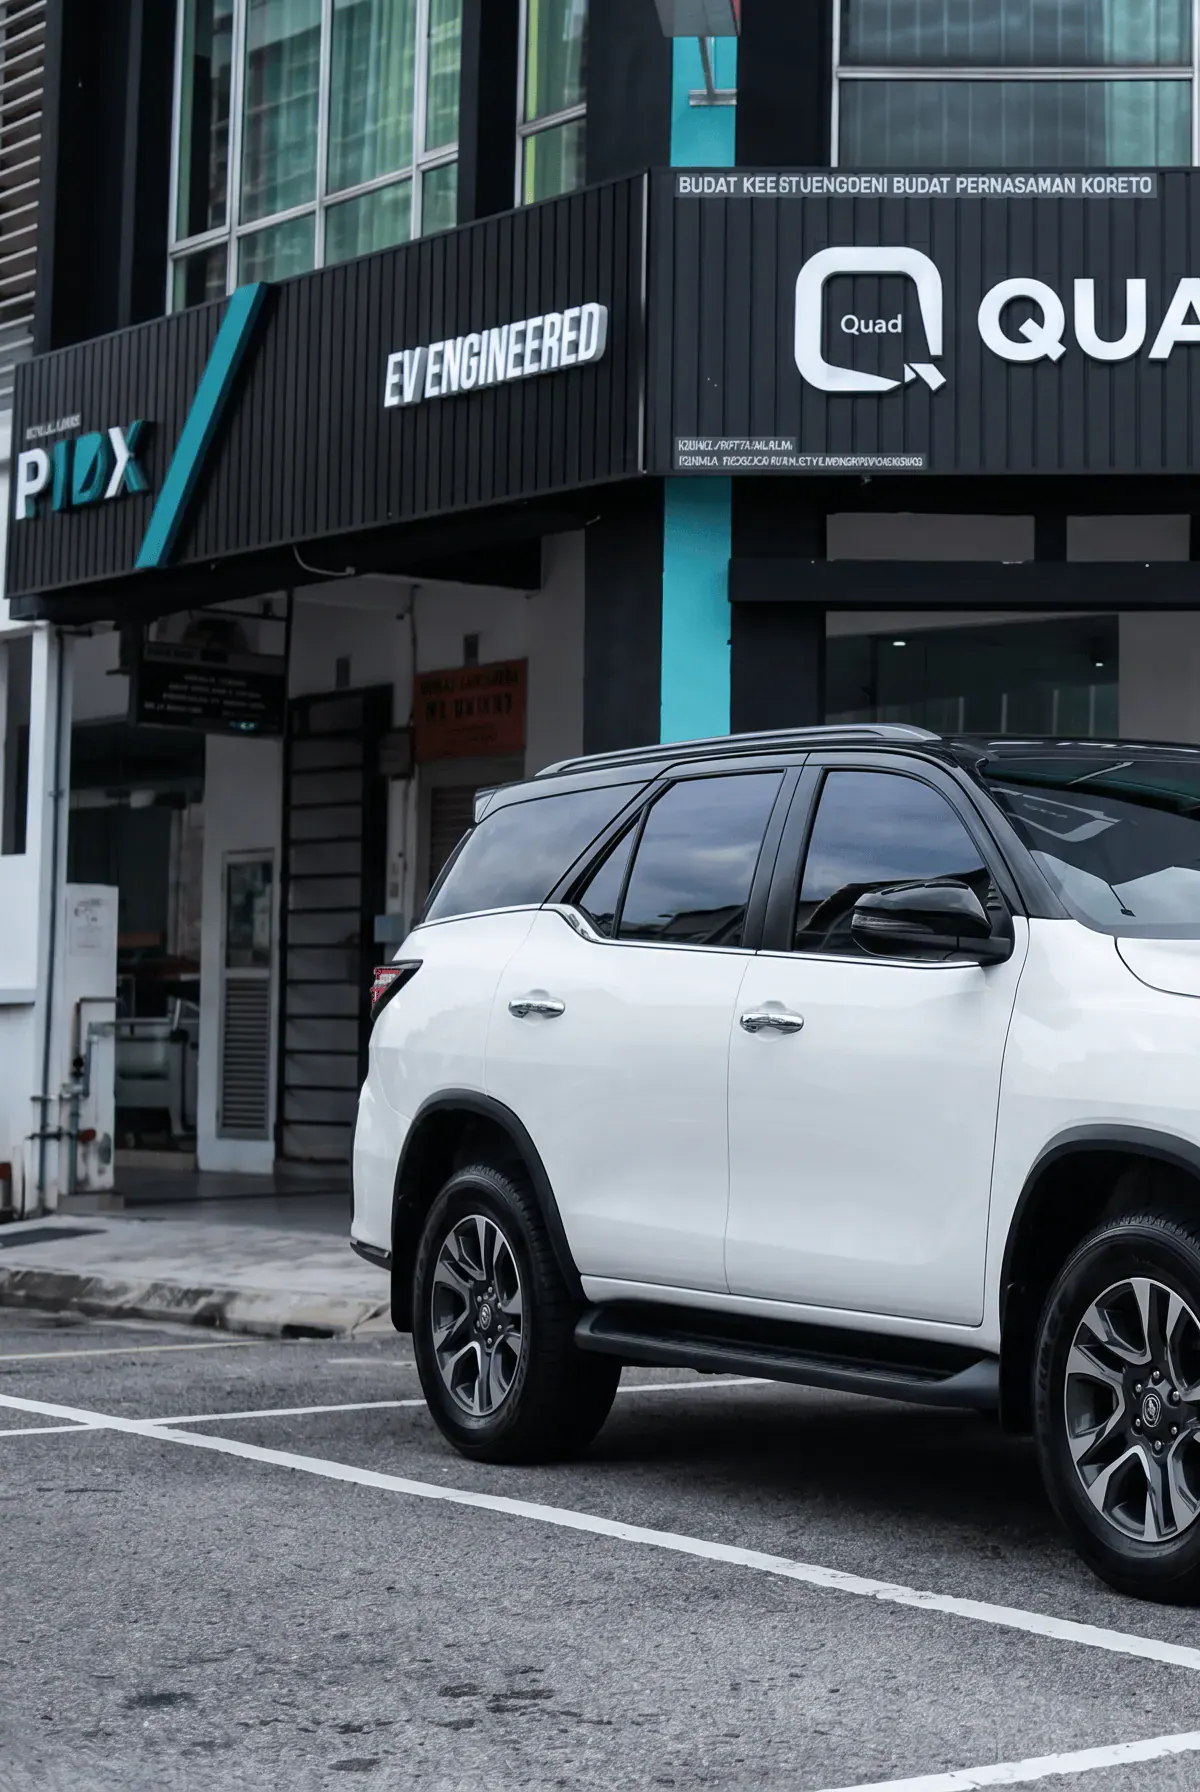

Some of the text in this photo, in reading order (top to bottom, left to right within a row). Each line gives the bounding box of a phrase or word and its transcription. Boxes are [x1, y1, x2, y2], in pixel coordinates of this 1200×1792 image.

[679, 176, 738, 193] BUDAT
[893, 176, 950, 193] BUDAT
[956, 176, 1076, 193] PERNASAMAN
[1081, 176, 1152, 193] KORETO
[840, 313, 902, 335] Quad
[384, 302, 607, 407] EV ENGINEERED
